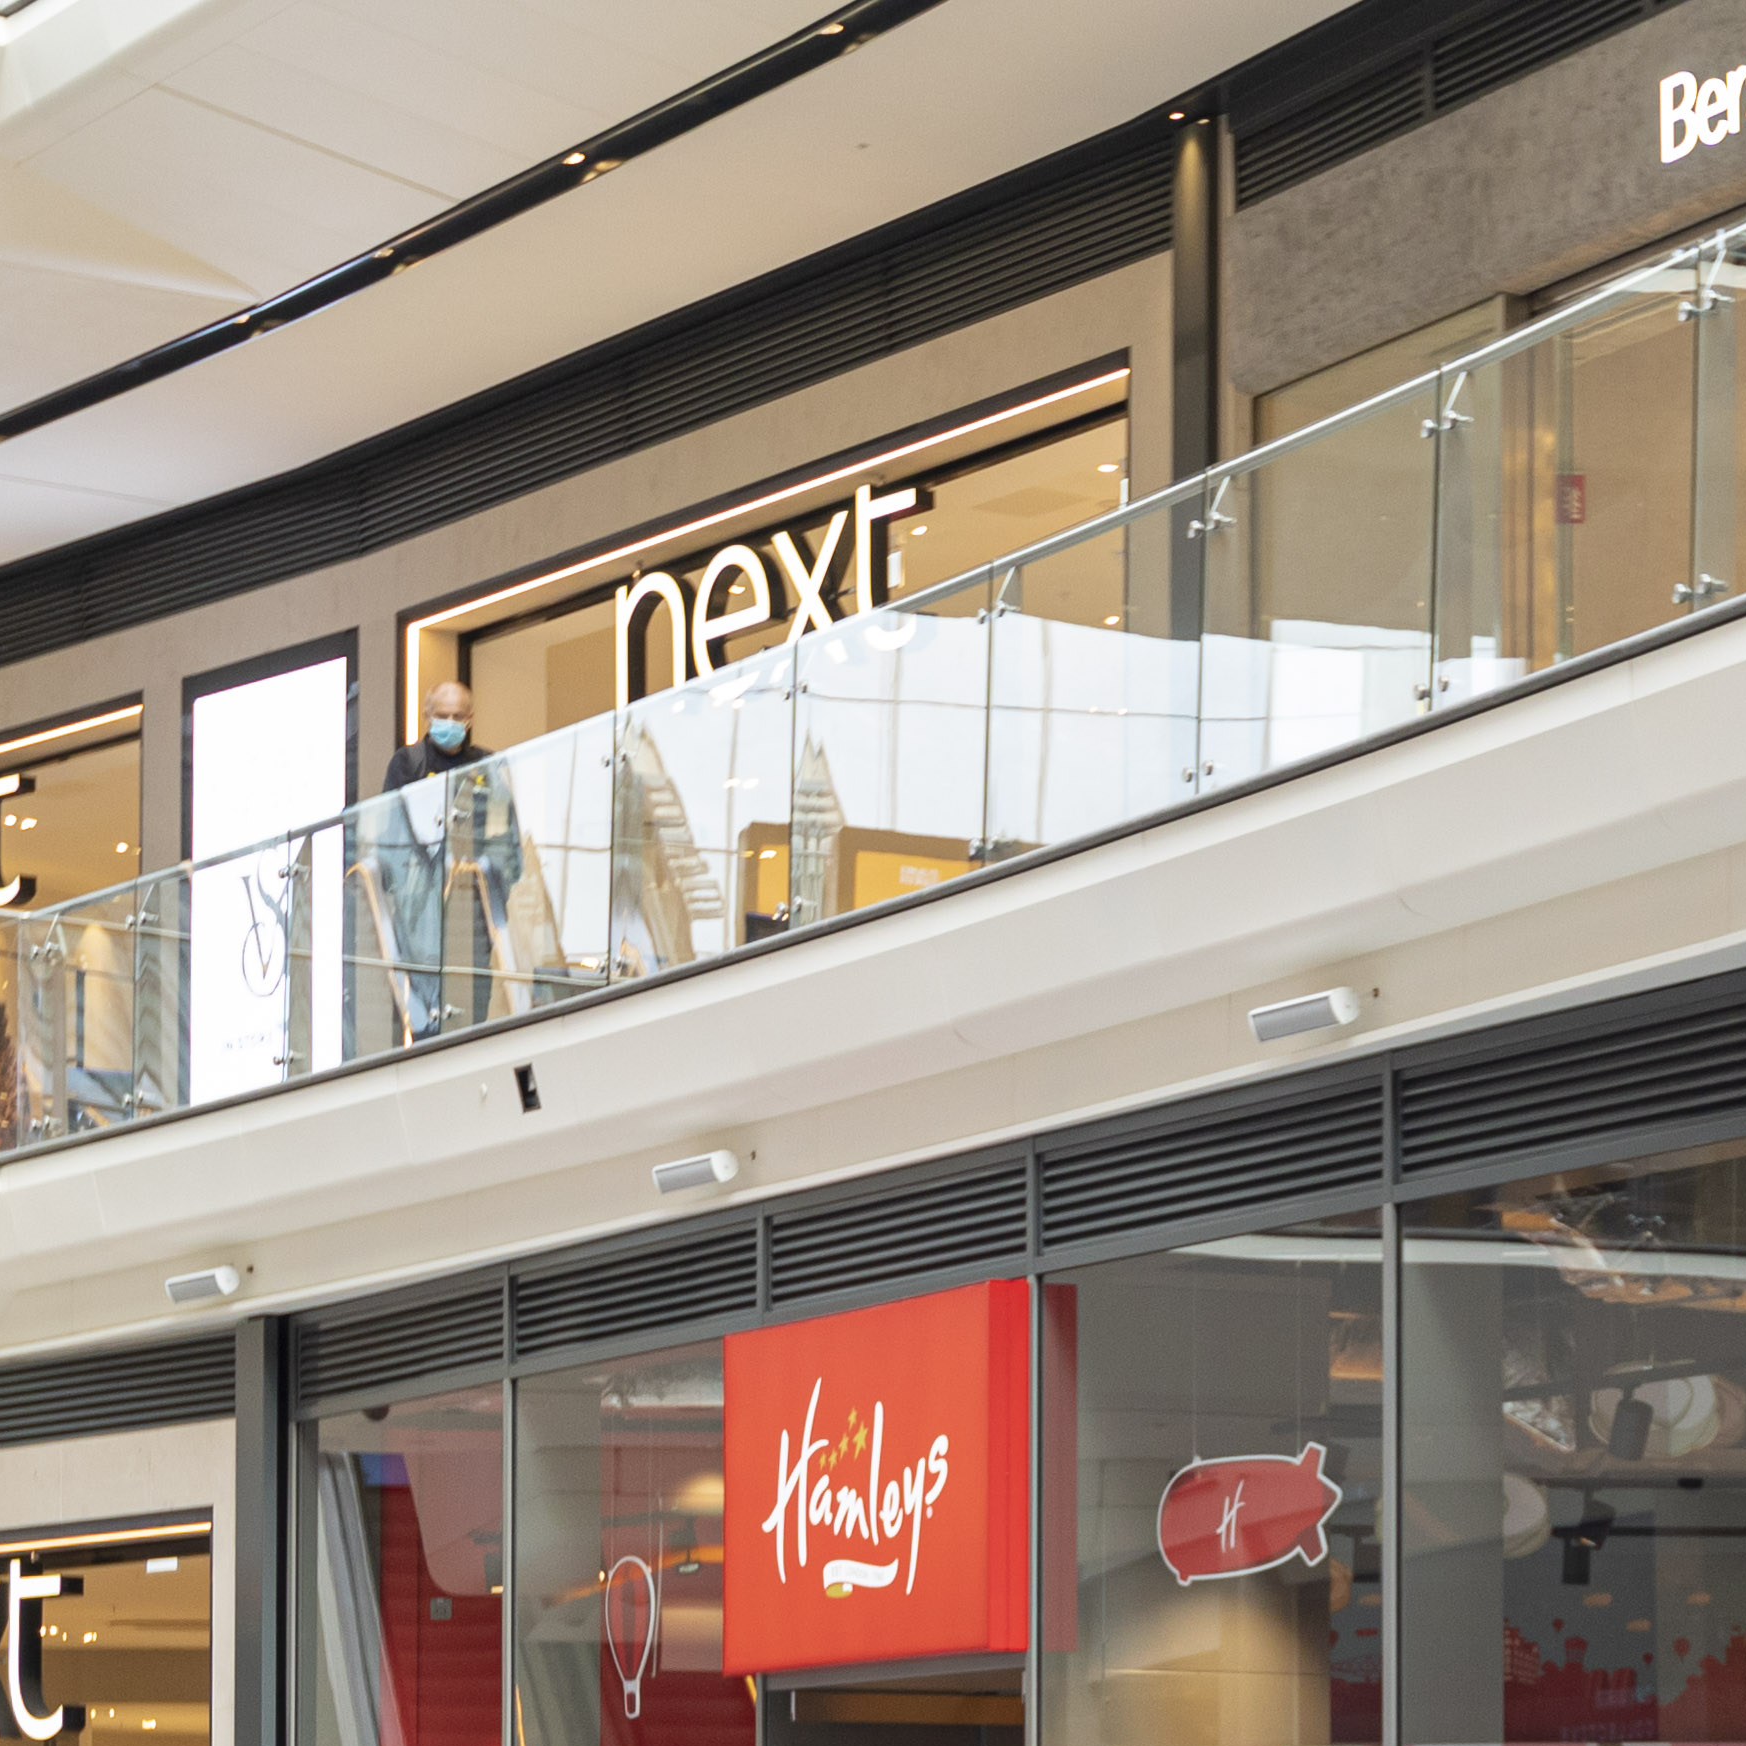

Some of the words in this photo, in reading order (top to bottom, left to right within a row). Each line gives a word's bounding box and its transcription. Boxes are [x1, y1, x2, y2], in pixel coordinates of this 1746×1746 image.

[615, 483, 916, 713] next
[761, 1376, 949, 1596] Hamleys
[1215, 1479, 1246, 1554] H
